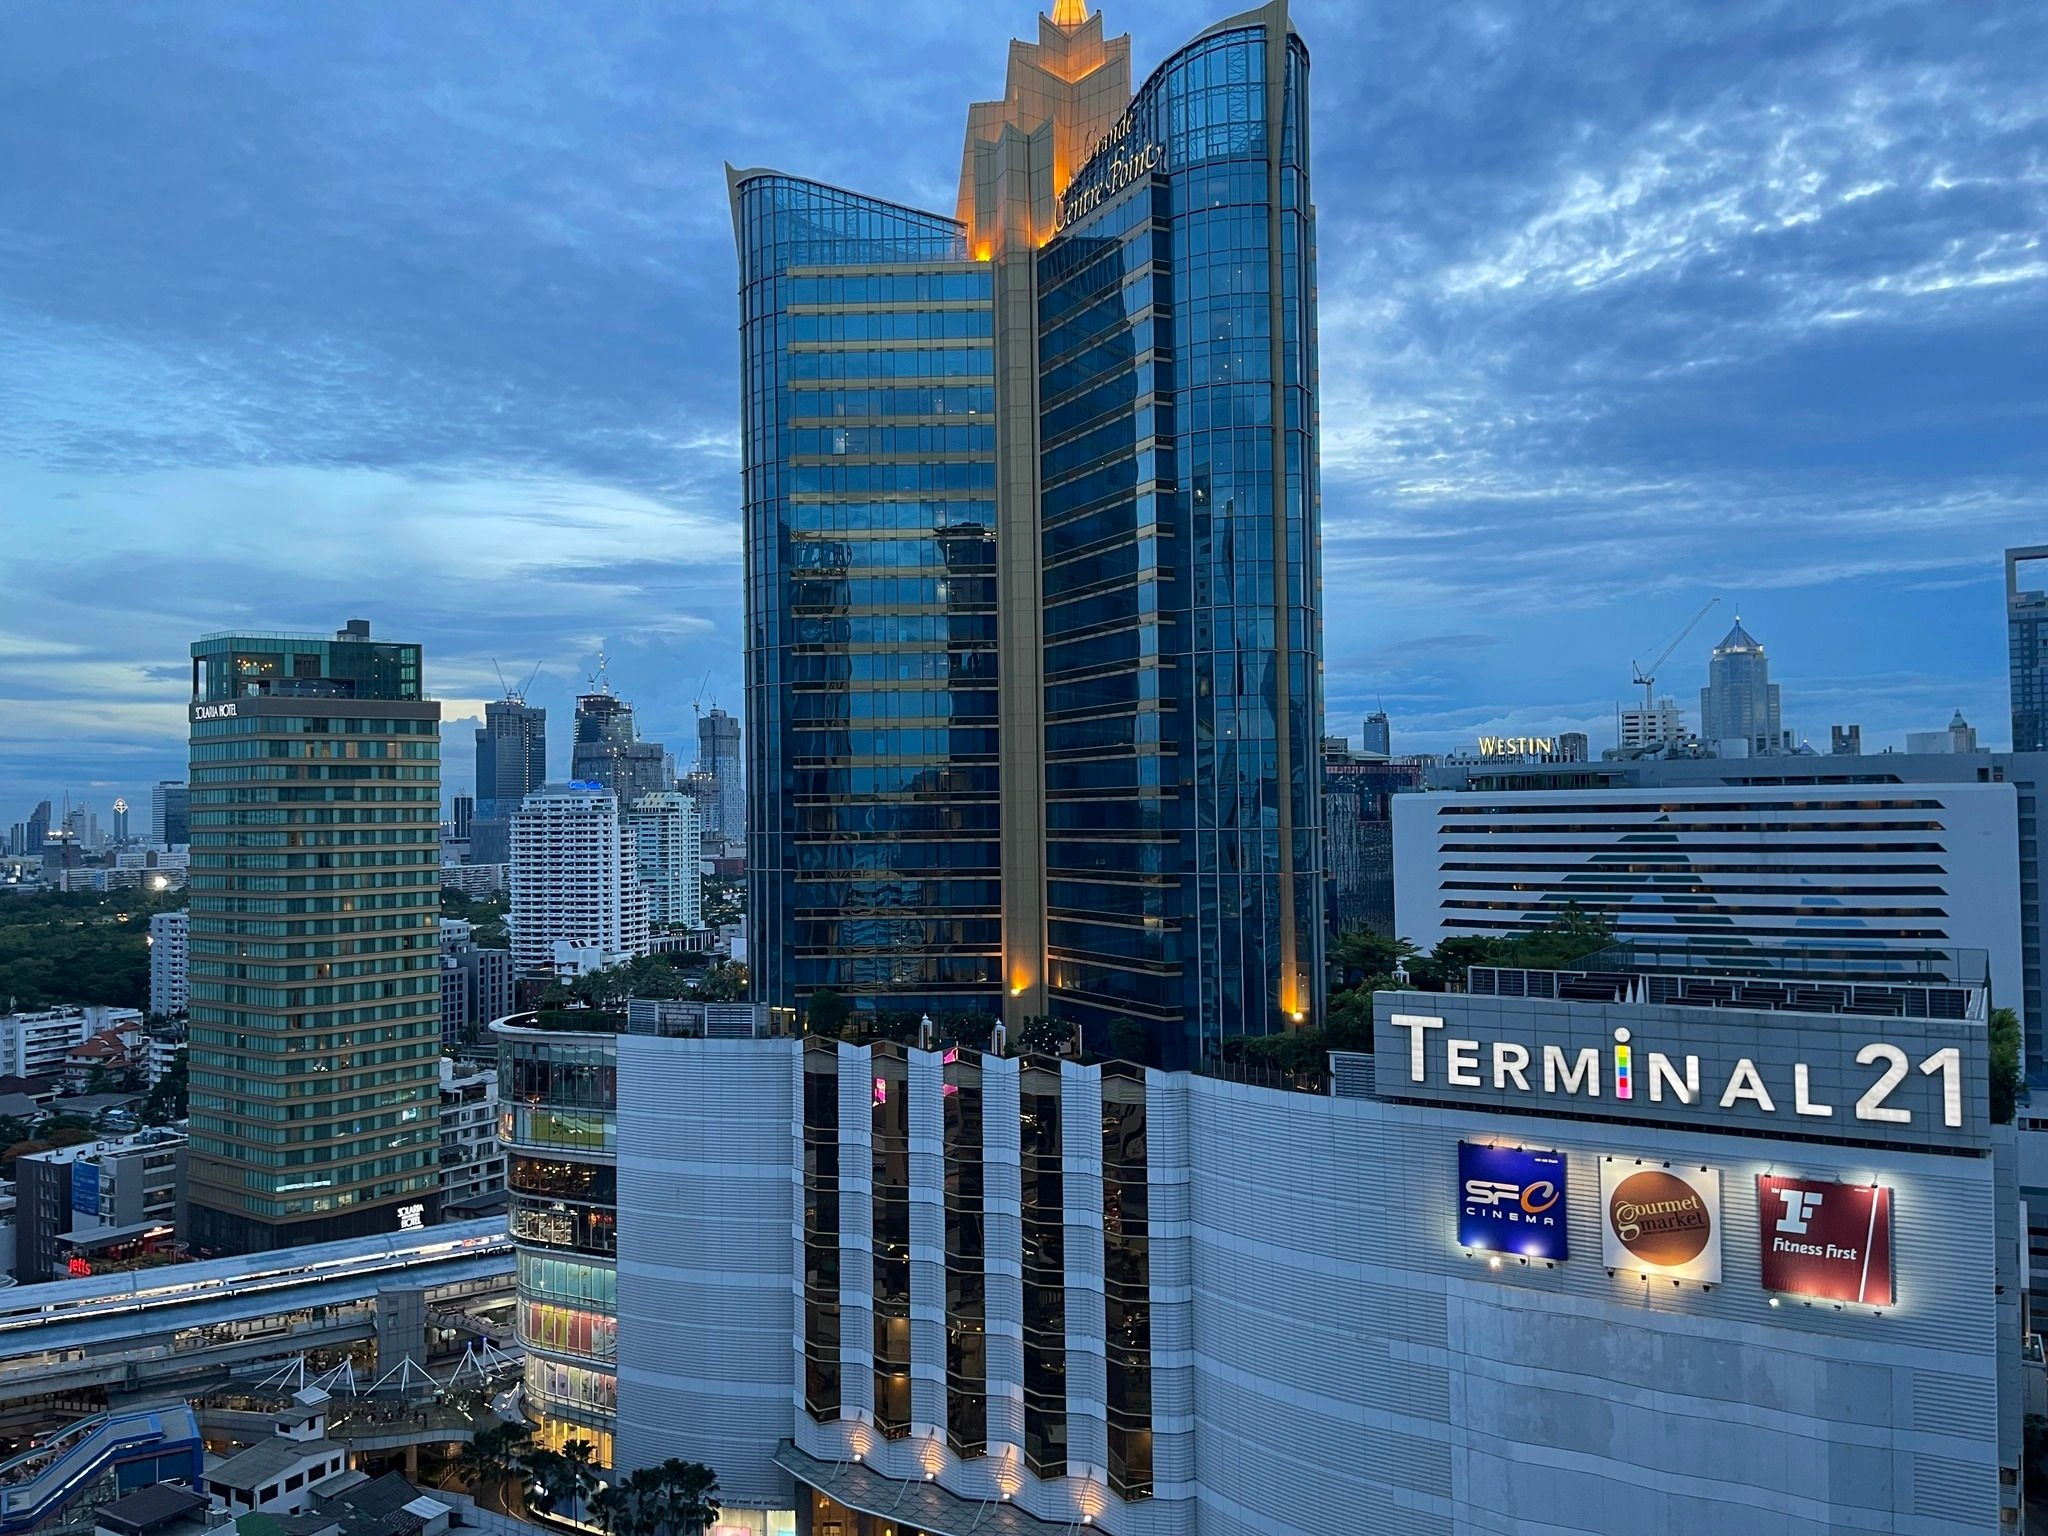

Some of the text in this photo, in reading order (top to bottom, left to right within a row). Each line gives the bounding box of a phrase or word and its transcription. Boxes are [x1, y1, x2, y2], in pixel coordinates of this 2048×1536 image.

[1083, 107, 1134, 163] Grande
[1054, 140, 1160, 232] Centre Point
[219, 703, 237, 717] HOTEL
[1855, 1043, 1963, 1128] 21
[401, 1216, 423, 1229] HOTEL
[1466, 1206, 1555, 1226] CINEMA
[1615, 1194, 1700, 1241] gourmet
[1640, 1211, 1705, 1232] market
[1773, 1237, 1858, 1261] Fitness First
